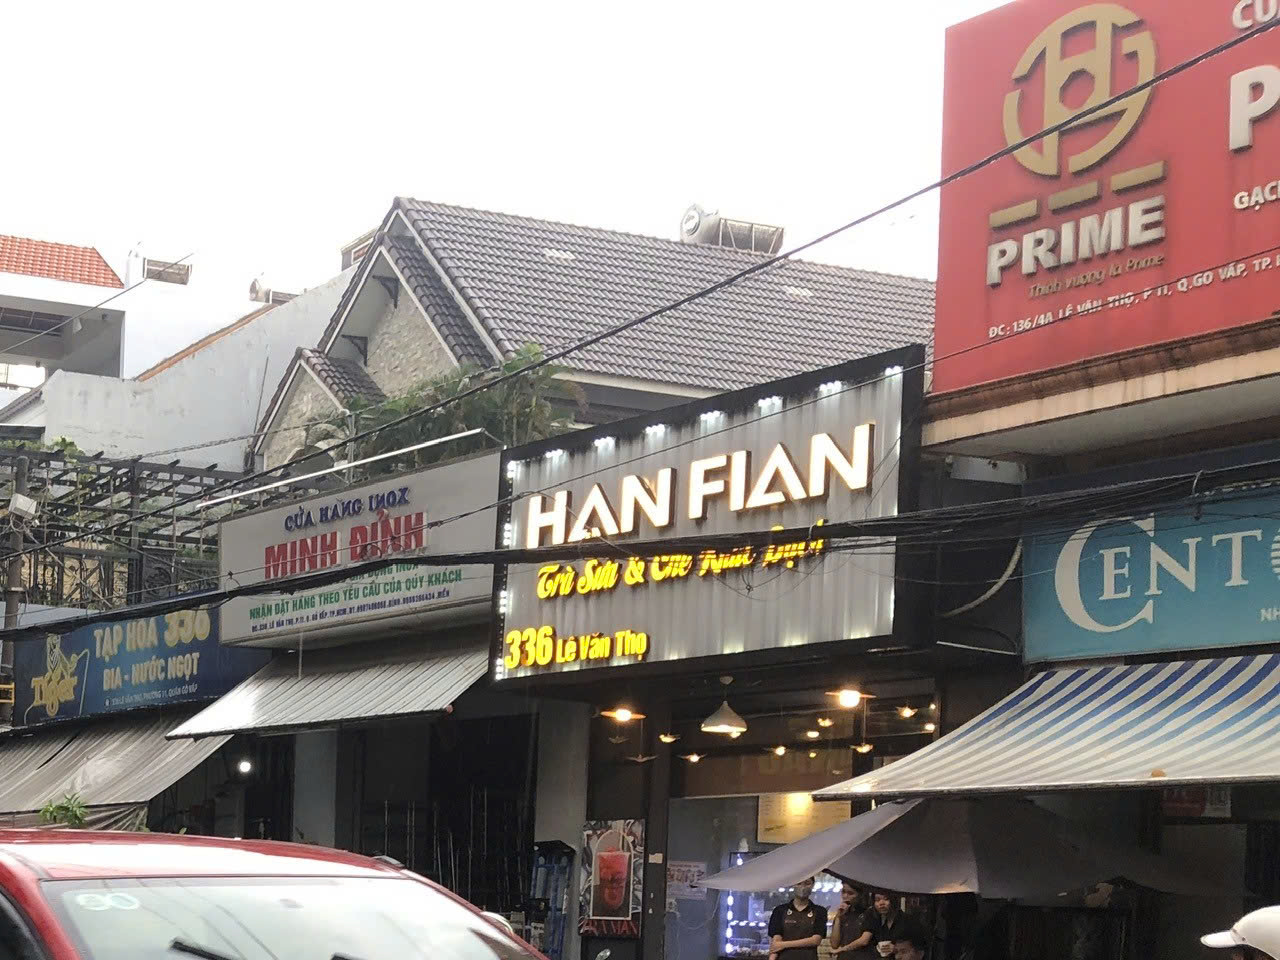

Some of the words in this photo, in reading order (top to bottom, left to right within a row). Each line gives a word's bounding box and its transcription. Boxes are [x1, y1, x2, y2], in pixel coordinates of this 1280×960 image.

[986, 195, 1166, 287] PRIME
[526, 467, 674, 550] HAN
[689, 423, 874, 520] FIAN
[264, 531, 340, 580] MINH
[250, 604, 273, 621] NHẬN
[319, 591, 340, 605] THEO
[428, 567, 462, 586] KHÁCH
[94, 624, 124, 663] TẠP
[504, 626, 553, 669] 336
[556, 636, 577, 663] Lê
[579, 632, 611, 660] Văn
[615, 629, 648, 661] Thọ
